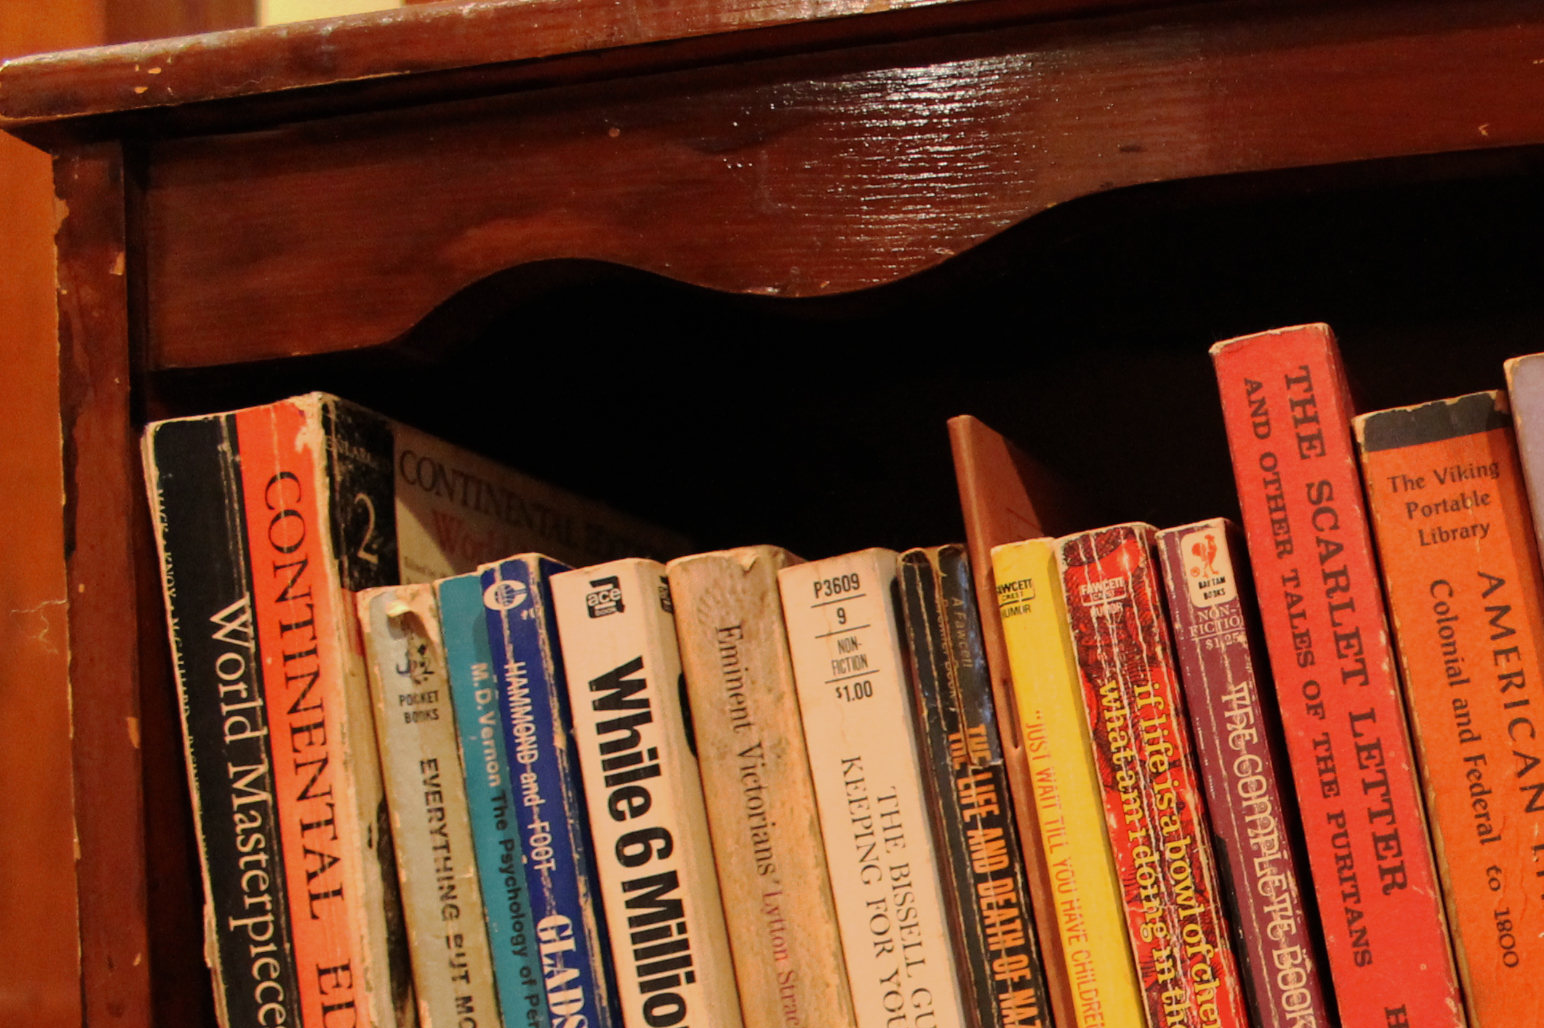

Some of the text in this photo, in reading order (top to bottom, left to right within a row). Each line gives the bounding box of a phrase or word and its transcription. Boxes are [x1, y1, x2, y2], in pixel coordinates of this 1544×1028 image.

[1387, 462, 1501, 493] The Viking
[1405, 491, 1491, 520] Portable
[1418, 522, 1490, 547] Library
[813, 573, 861, 598] P3609
[831, 654, 869, 676] FICTION
[1282, 364, 1408, 896] THE SCARLET LETTER
[205, 591, 266, 743] World
[259, 468, 348, 921] CONTINENTAL
[835, 681, 873, 702] $1.00
[1242, 375, 1372, 968] AND OTHER TALES OF THE PURITANS
[584, 654, 654, 823] While
[1218, 681, 1258, 752] THE
[500, 661, 556, 875] HAMMOND and FOOT
[714, 622, 756, 734] Eminent
[758, 889, 789, 962] Lytton
[955, 771, 1000, 823] LIFE
[1033, 766, 1061, 812] WAIT
[1427, 577, 1521, 970] Colonial and Federal to 1800
[416, 757, 462, 921] EVERYTHING
[488, 794, 510, 832] The
[874, 785, 906, 854] THE
[1042, 817, 1069, 855] TILL
[1095, 679, 1133, 766] what
[1129, 843, 1166, 943] doing
[1139, 714, 1212, 960] life bowl of
[1229, 751, 1297, 939] COMPLETE
[611, 824, 676, 870] 6
[839, 755, 883, 886] KEEPING
[865, 897, 895, 958] FOR
[966, 824, 1010, 875] AND
[1051, 856, 1077, 895] YOU
[495, 838, 531, 958] Psychology
[887, 861, 928, 978] BISSELL
[976, 877, 1025, 951] DEATH
[1060, 897, 1088, 946] HAVE
[517, 963, 537, 988] of
[991, 953, 1031, 986] OF
